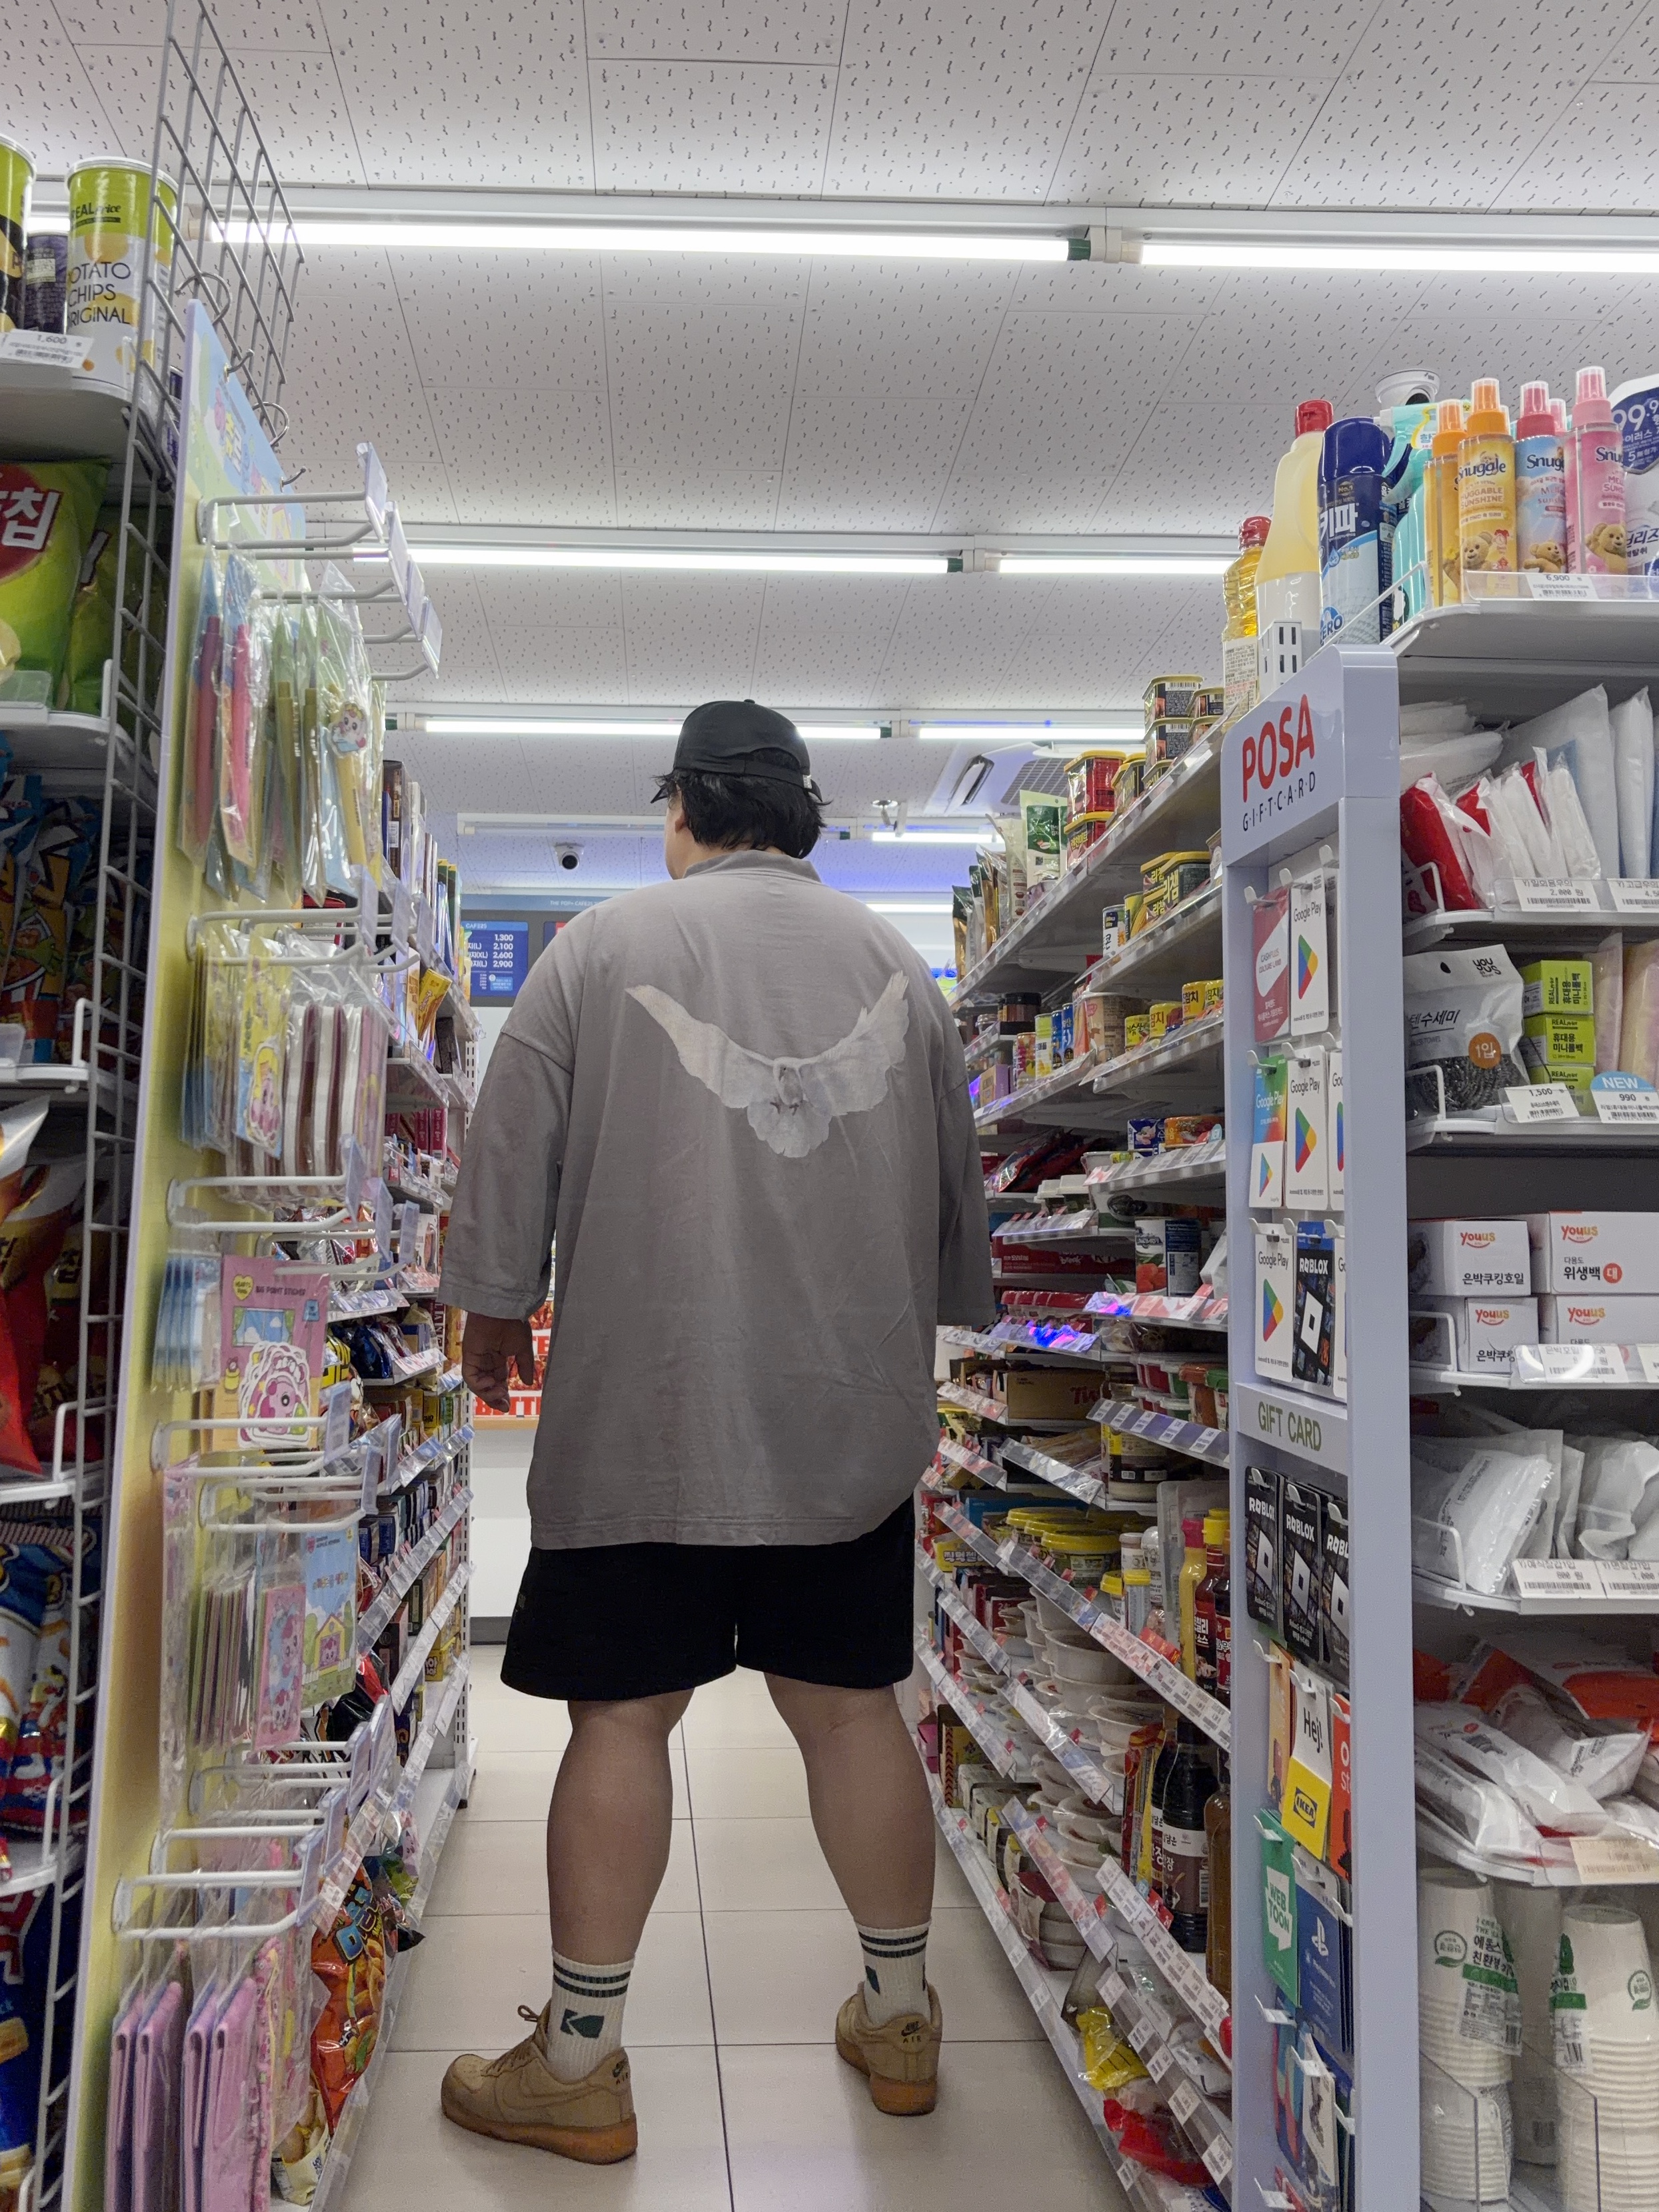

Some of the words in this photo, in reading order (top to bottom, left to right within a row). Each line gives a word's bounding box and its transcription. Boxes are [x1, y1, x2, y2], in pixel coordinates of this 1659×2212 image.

[69, 283, 116, 307] CHIPS
[37, 335, 67, 344] 1,600
[1458, 457, 1506, 477] Snuggle
[1546, 574, 1570, 582] 6,900
[1242, 693, 1315, 803] POSA
[1293, 904, 1310, 923] Google
[1311, 901, 1322, 917] Play
[494, 933, 514, 941] 1,300
[493, 943, 514, 951] 2,100
[493, 960, 514, 968] 2,900
[1553, 1033, 1576, 1043] 휴대용
[1474, 1041, 1495, 1059] 1입
[1290, 1079, 1308, 1097] Google
[1309, 1077, 1320, 1094] Play
[1602, 1077, 1639, 1089] NEW
[1529, 1088, 1553, 1097] 1,500
[1619, 1093, 1637, 1101] 990
[1256, 1093, 1274, 1111] Google
[1460, 1231, 1496, 1246] youus
[1560, 1225, 1599, 1241] youus
[1258, 1251, 1276, 1269] Google
[1277, 1253, 1289, 1270] Play
[1299, 1257, 1328, 1275] ROBLOX
[1564, 1256, 1584, 1265] 다용도
[1462, 1272, 1524, 1285] 은박쿠킹호일
[1564, 1266, 1601, 1281] 위생백
[1606, 1267, 1618, 1280] 대
[1475, 1309, 1510, 1323] youus
[1568, 1307, 1606, 1323] youus
[1258, 1401, 1283, 1437] GIFT
[1288, 1411, 1322, 1452] CARD
[1249, 1496, 1276, 1522] ROBLOX
[1286, 1513, 1315, 1543] ROBLOX
[1303, 1707, 1324, 1753] Hej!
[1296, 1795, 1314, 1820] IKEA
[1269, 1881, 1287, 1913] WEB
[1268, 1898, 1290, 1933] TOON
